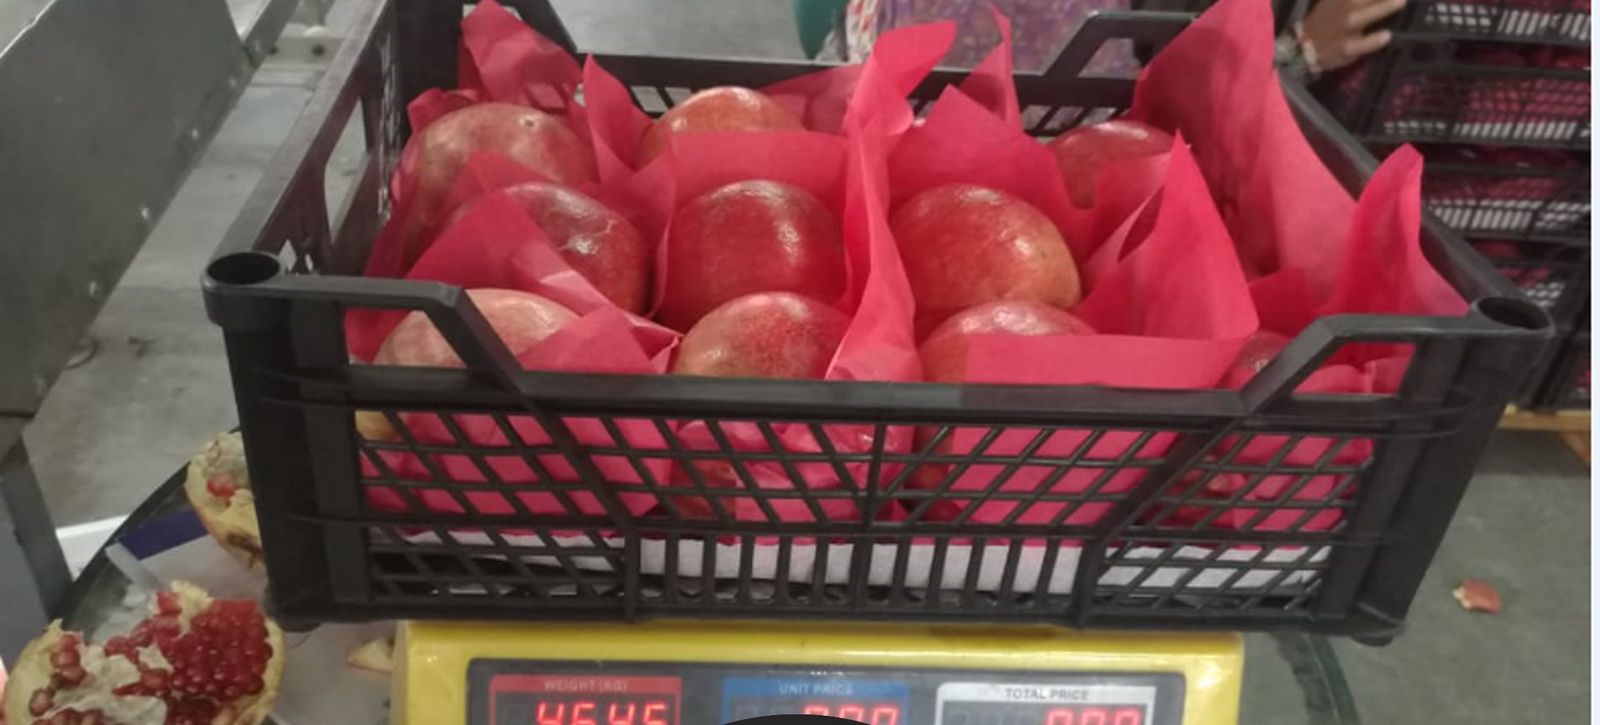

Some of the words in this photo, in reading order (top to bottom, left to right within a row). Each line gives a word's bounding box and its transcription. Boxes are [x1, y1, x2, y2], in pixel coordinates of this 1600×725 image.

[544, 679, 595, 692] WEIGHT
[779, 682, 809, 695] UNIT
[813, 683, 854, 696] PRICE
[1005, 687, 1047, 699] TOTAL
[1050, 688, 1089, 700] PRICE
